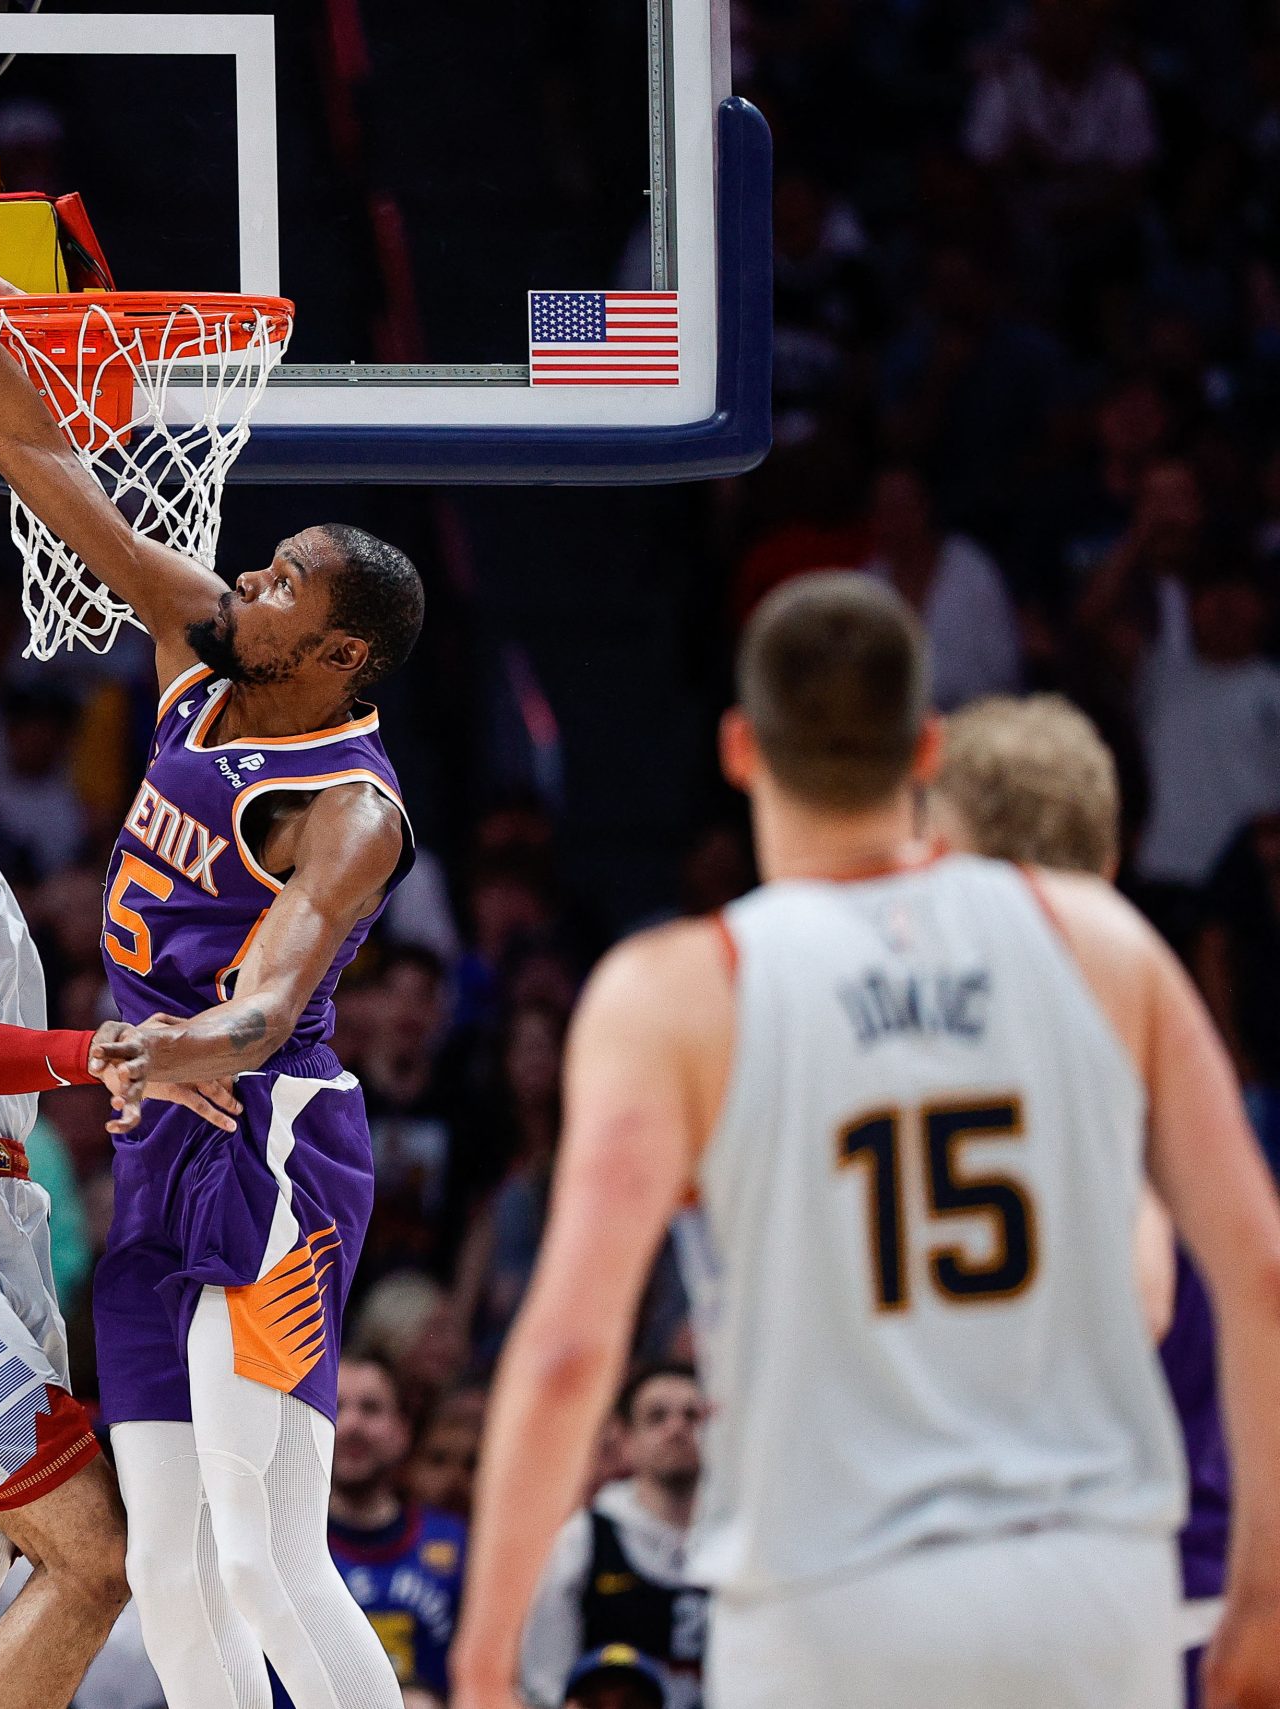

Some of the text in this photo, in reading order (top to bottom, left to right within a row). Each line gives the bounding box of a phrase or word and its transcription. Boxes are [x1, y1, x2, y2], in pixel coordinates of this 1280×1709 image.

[214, 756, 246, 789] PayPal
[124, 777, 230, 897] ENIX
[104, 850, 175, 977] 5
[833, 1091, 1039, 1315] 15
